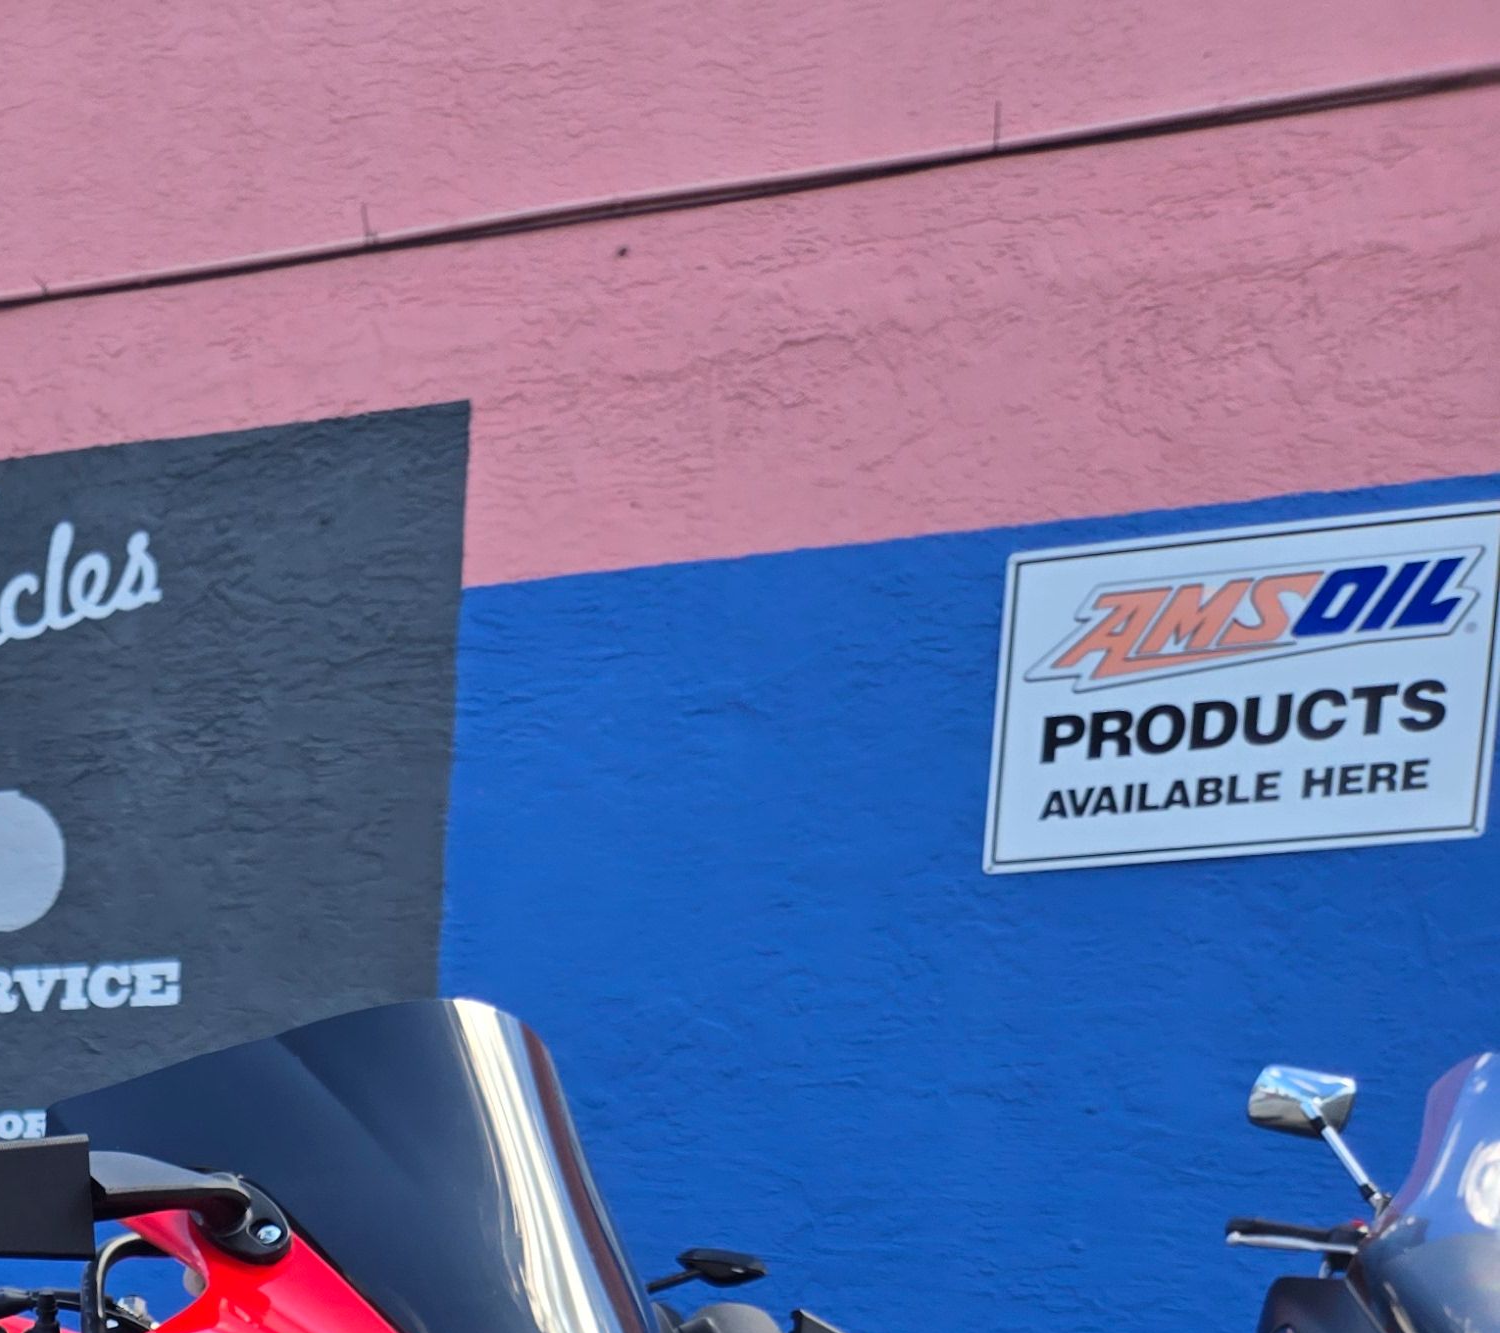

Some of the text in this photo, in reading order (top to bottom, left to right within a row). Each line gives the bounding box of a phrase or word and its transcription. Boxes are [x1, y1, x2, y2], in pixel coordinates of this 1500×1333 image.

[1051, 555, 1468, 681] AMSOIL
[1039, 679, 1448, 764] PRODUCTS
[1038, 759, 1430, 821] AVAILABLE HERE
